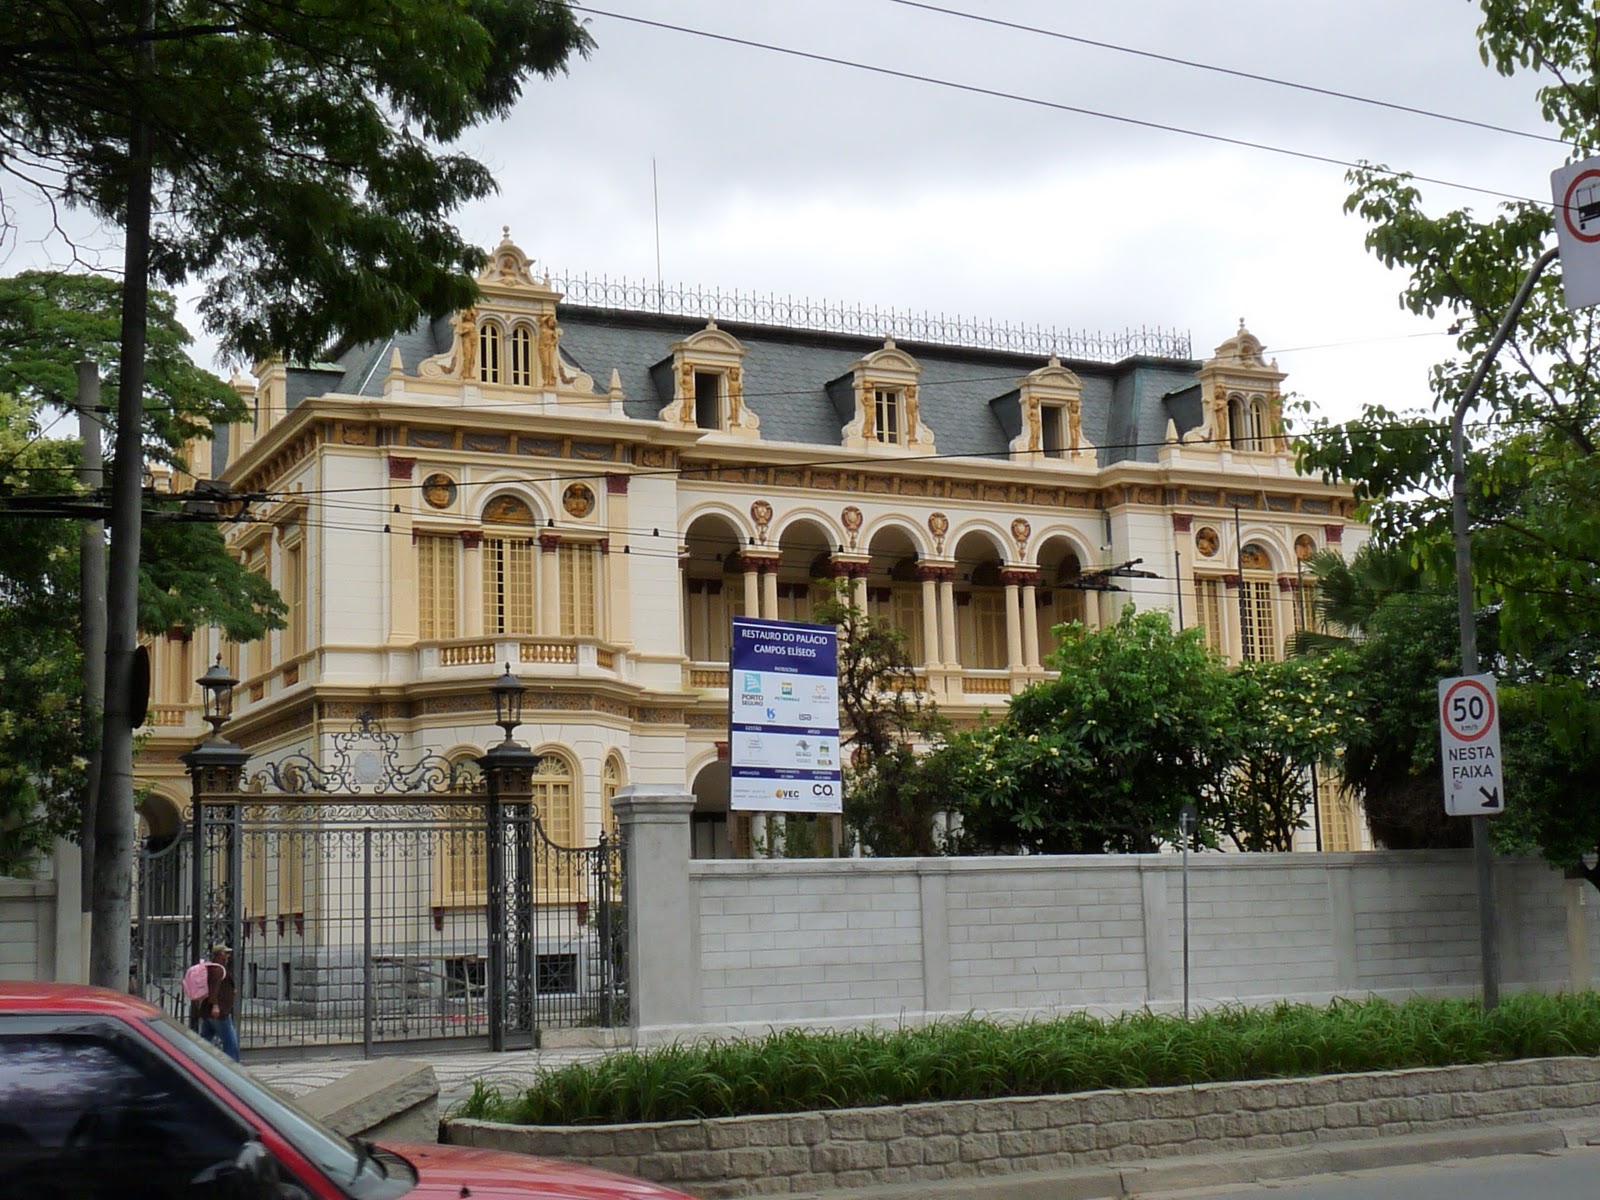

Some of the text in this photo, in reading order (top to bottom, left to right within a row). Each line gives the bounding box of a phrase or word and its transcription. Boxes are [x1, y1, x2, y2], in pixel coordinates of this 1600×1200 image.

[742, 629, 828, 645] RESTAURO DO PALÁCIO
[754, 644, 816, 657] CAMPOS ELÍSEOS
[1453, 696, 1484, 722] 50
[1449, 746, 1495, 761] NESTA
[1452, 764, 1494, 779] FAIXA
[783, 790, 800, 798] VEC
